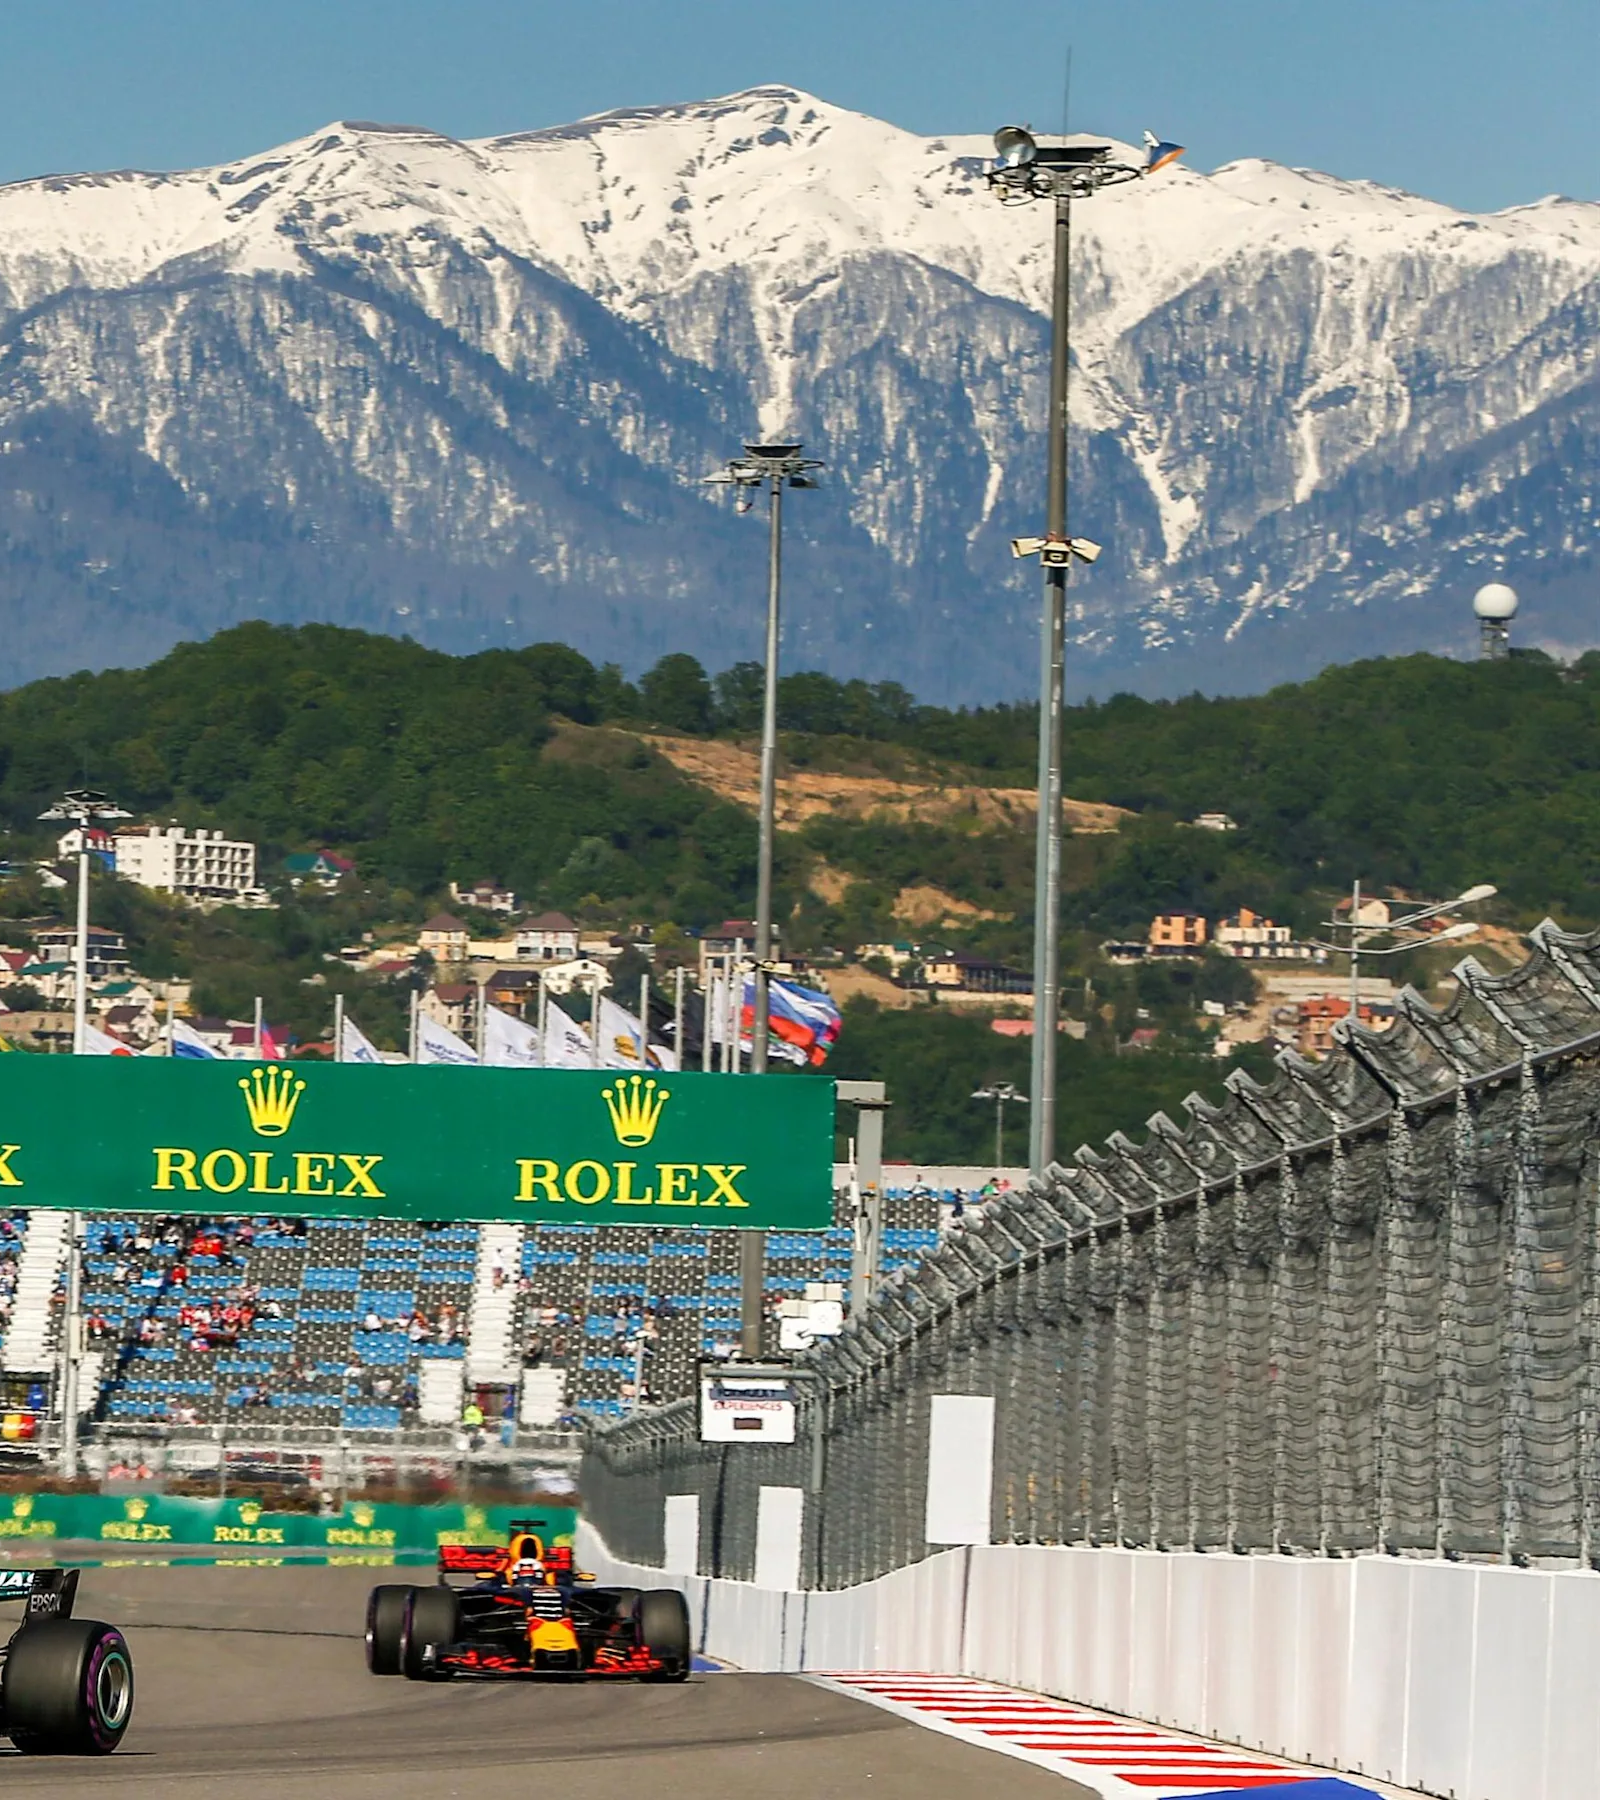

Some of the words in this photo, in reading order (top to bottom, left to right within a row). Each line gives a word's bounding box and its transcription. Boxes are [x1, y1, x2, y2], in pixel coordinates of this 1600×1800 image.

[152, 1147, 387, 1199] ROLEX
[514, 1158, 750, 1209] ROLEX
[213, 1525, 284, 1544] ROLEX
[30, 1593, 61, 1613] EPSON
